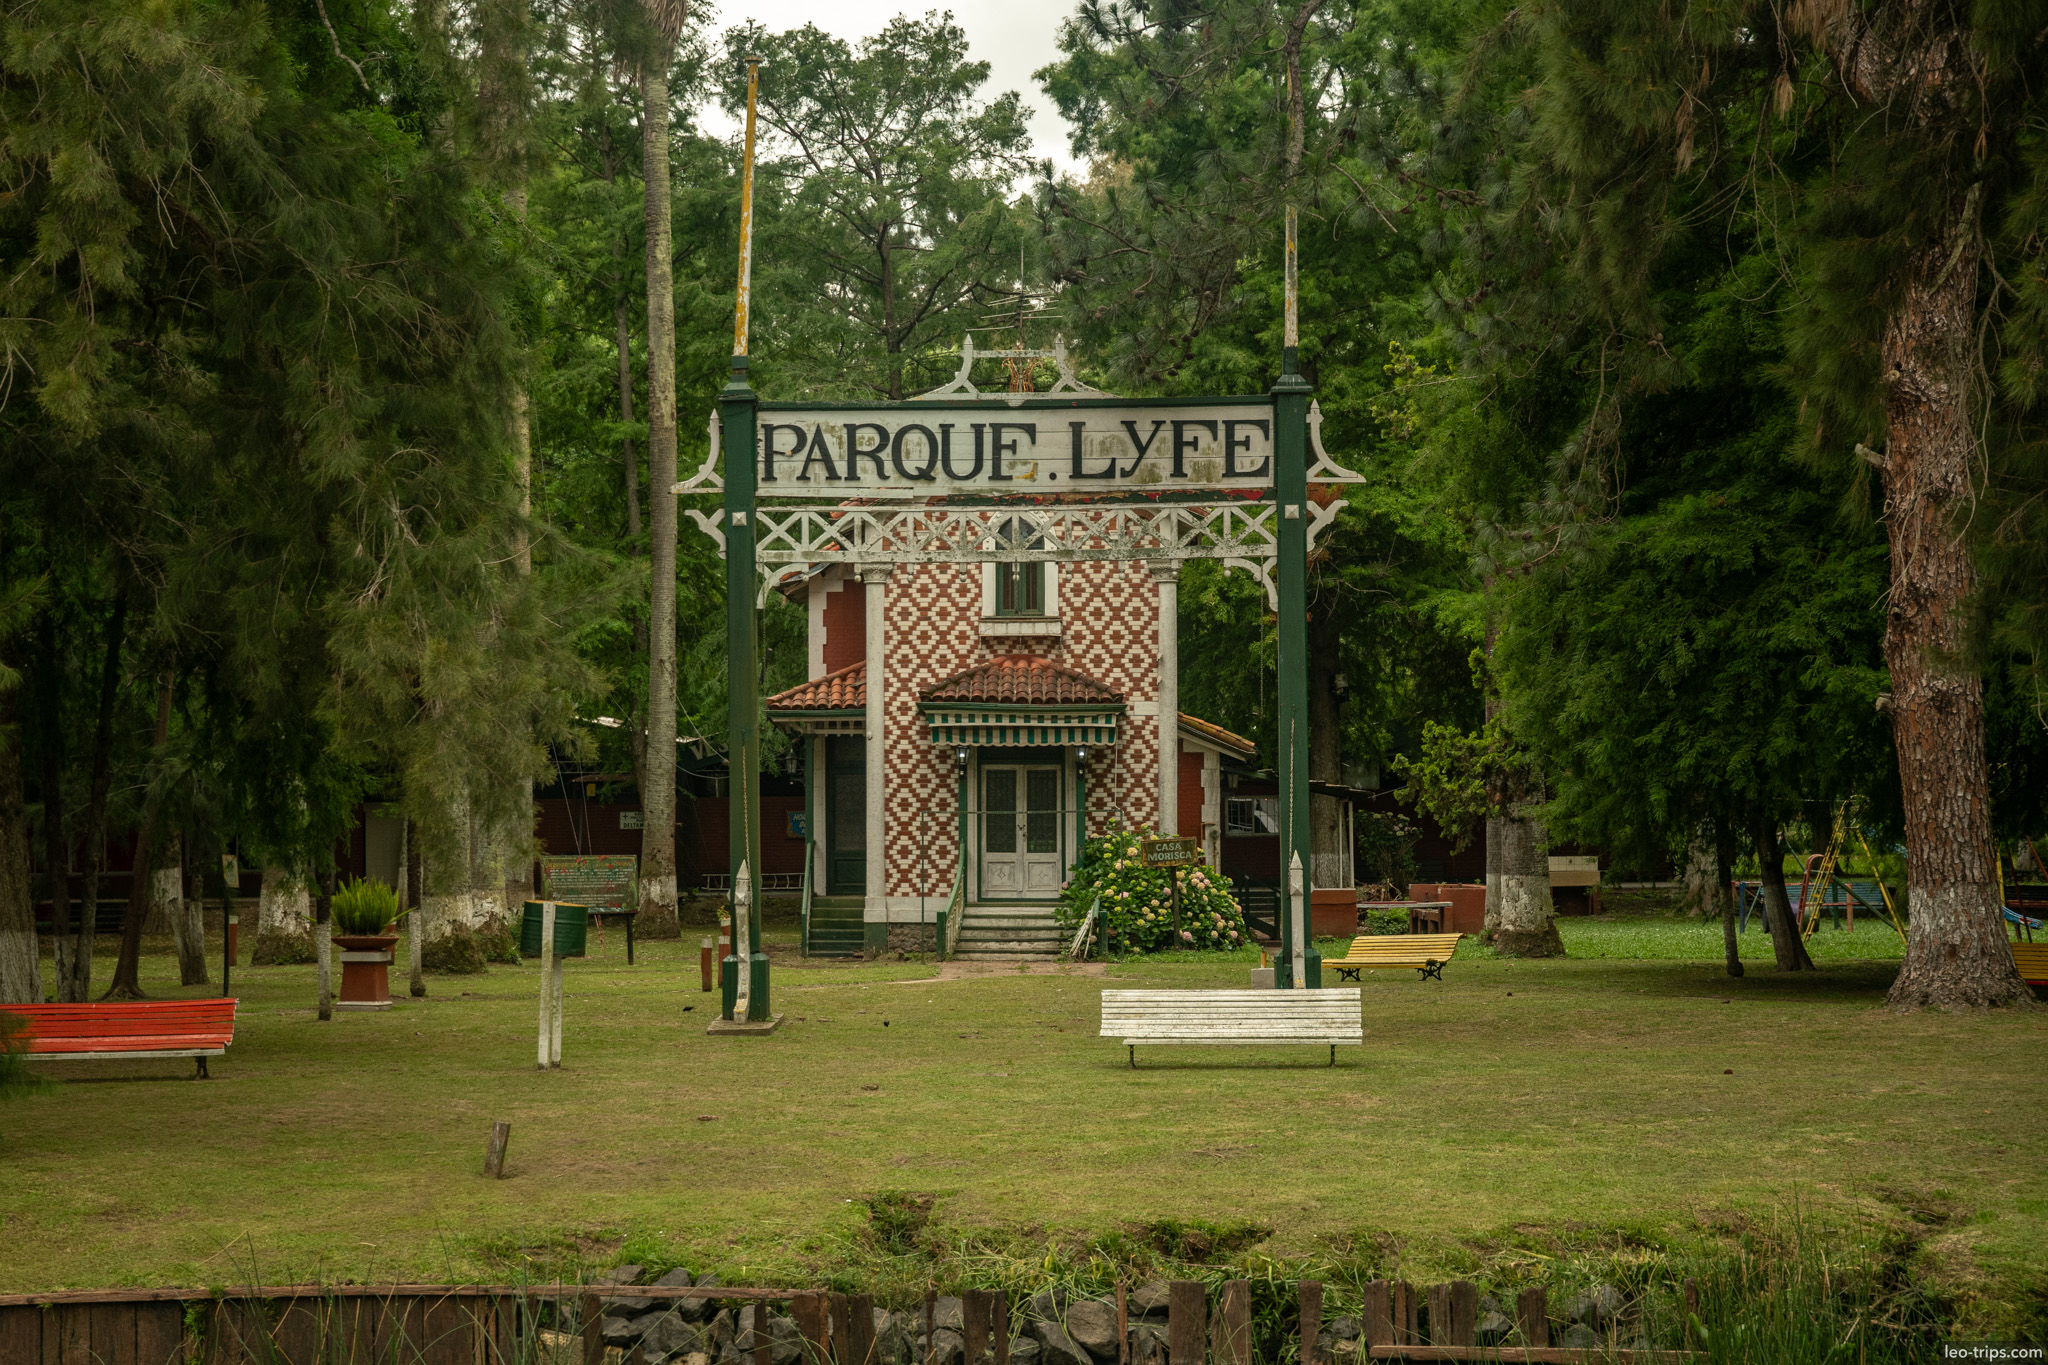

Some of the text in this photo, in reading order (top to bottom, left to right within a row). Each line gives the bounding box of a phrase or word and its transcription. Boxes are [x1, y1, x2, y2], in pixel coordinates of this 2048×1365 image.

[1069, 419, 1270, 479] LYFE
[1155, 843, 1182, 851] CASA
[1147, 851, 1192, 861] MORISCA
